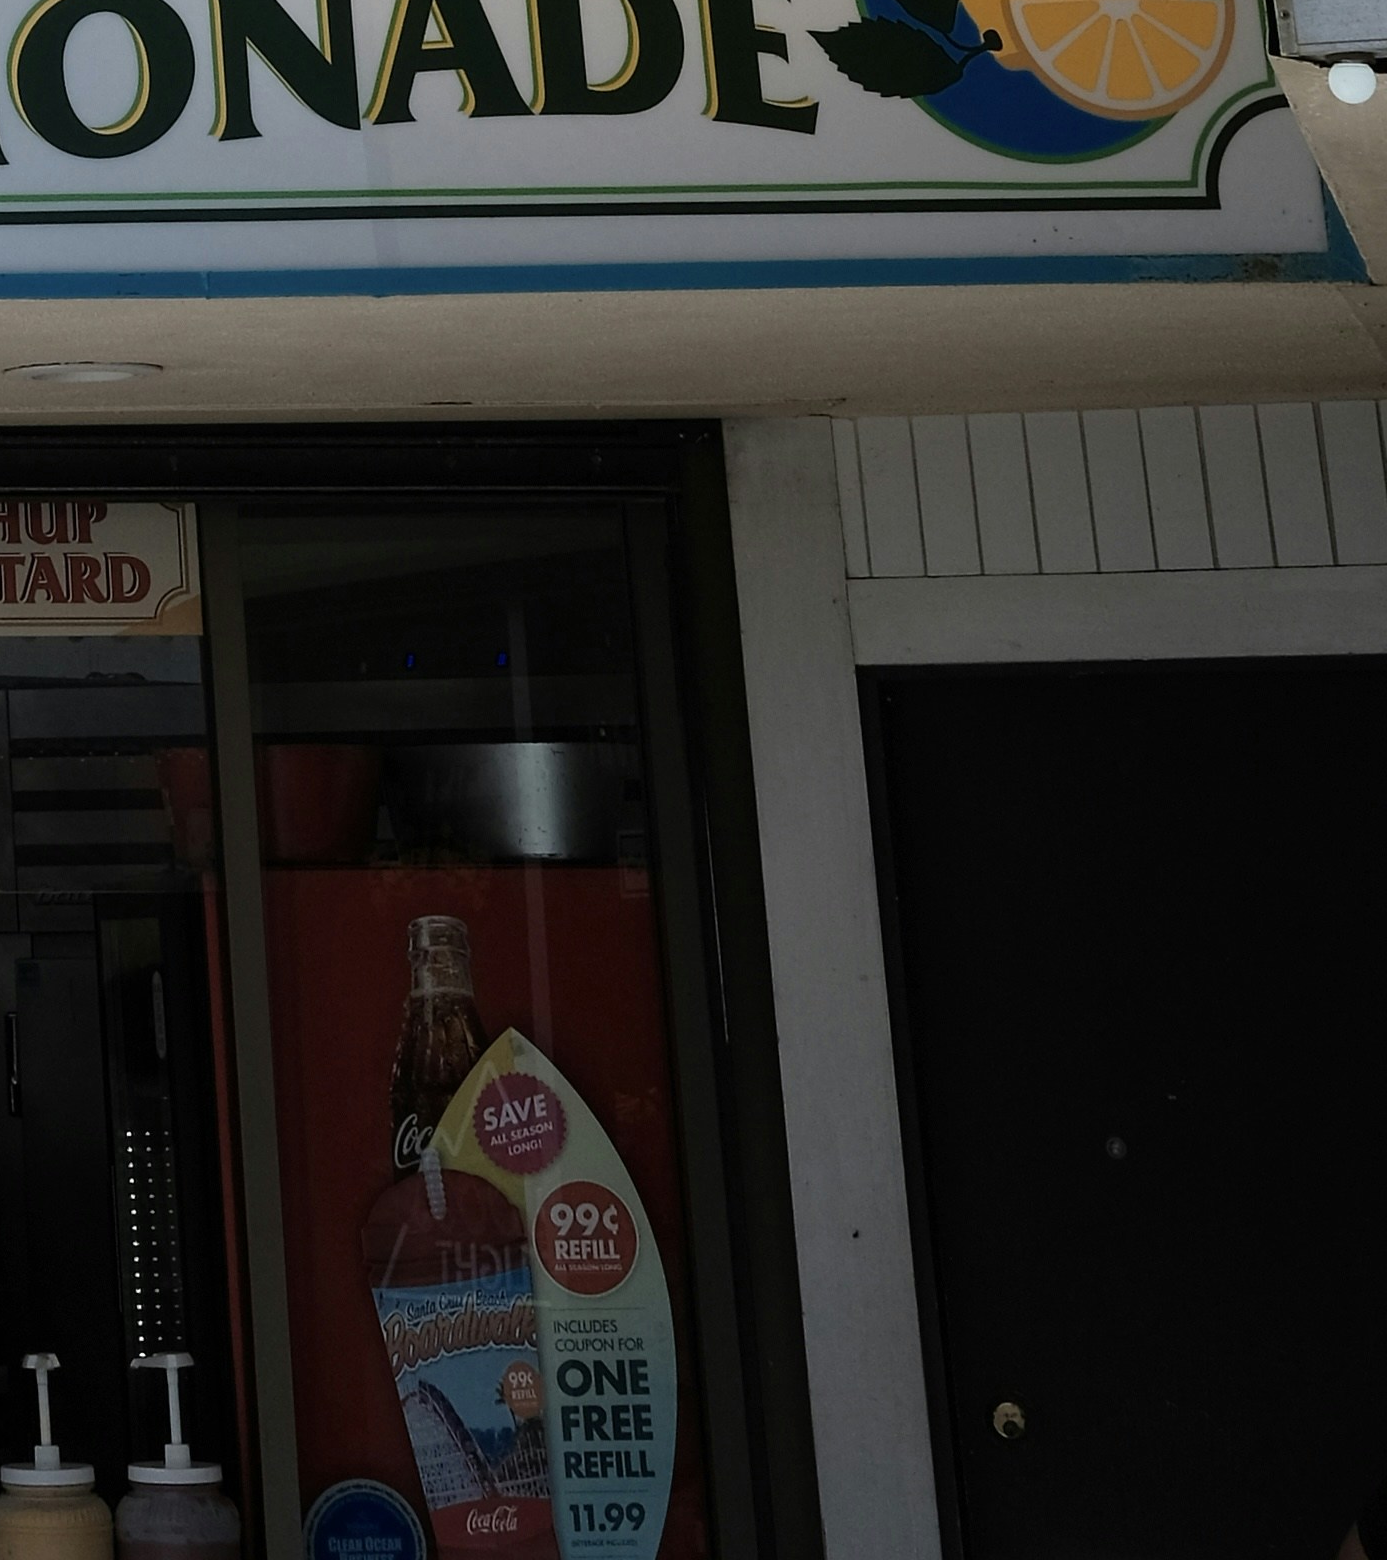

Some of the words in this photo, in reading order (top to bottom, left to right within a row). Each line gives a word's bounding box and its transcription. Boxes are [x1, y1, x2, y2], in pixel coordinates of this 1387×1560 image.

[482, 1093, 548, 1132] SAVE
[490, 1133, 508, 1147] ALL
[510, 1121, 554, 1142] SEASON
[507, 1138, 543, 1156] LONG!
[549, 1201, 620, 1236] 99¢
[553, 1239, 621, 1260] REFILL
[406, 1300, 436, 1321] Santa
[474, 1289, 508, 1308] Beach
[553, 1320, 618, 1334] INCLUDES
[554, 1338, 615, 1352] COUPON
[618, 1337, 644, 1351] FOR
[508, 1371, 534, 1389] 99¢
[556, 1359, 650, 1397] ONE
[511, 1388, 537, 1400] REFILL
[560, 1404, 654, 1441] FREE
[563, 1450, 655, 1478] REFILL
[569, 1502, 646, 1532] 11.99
